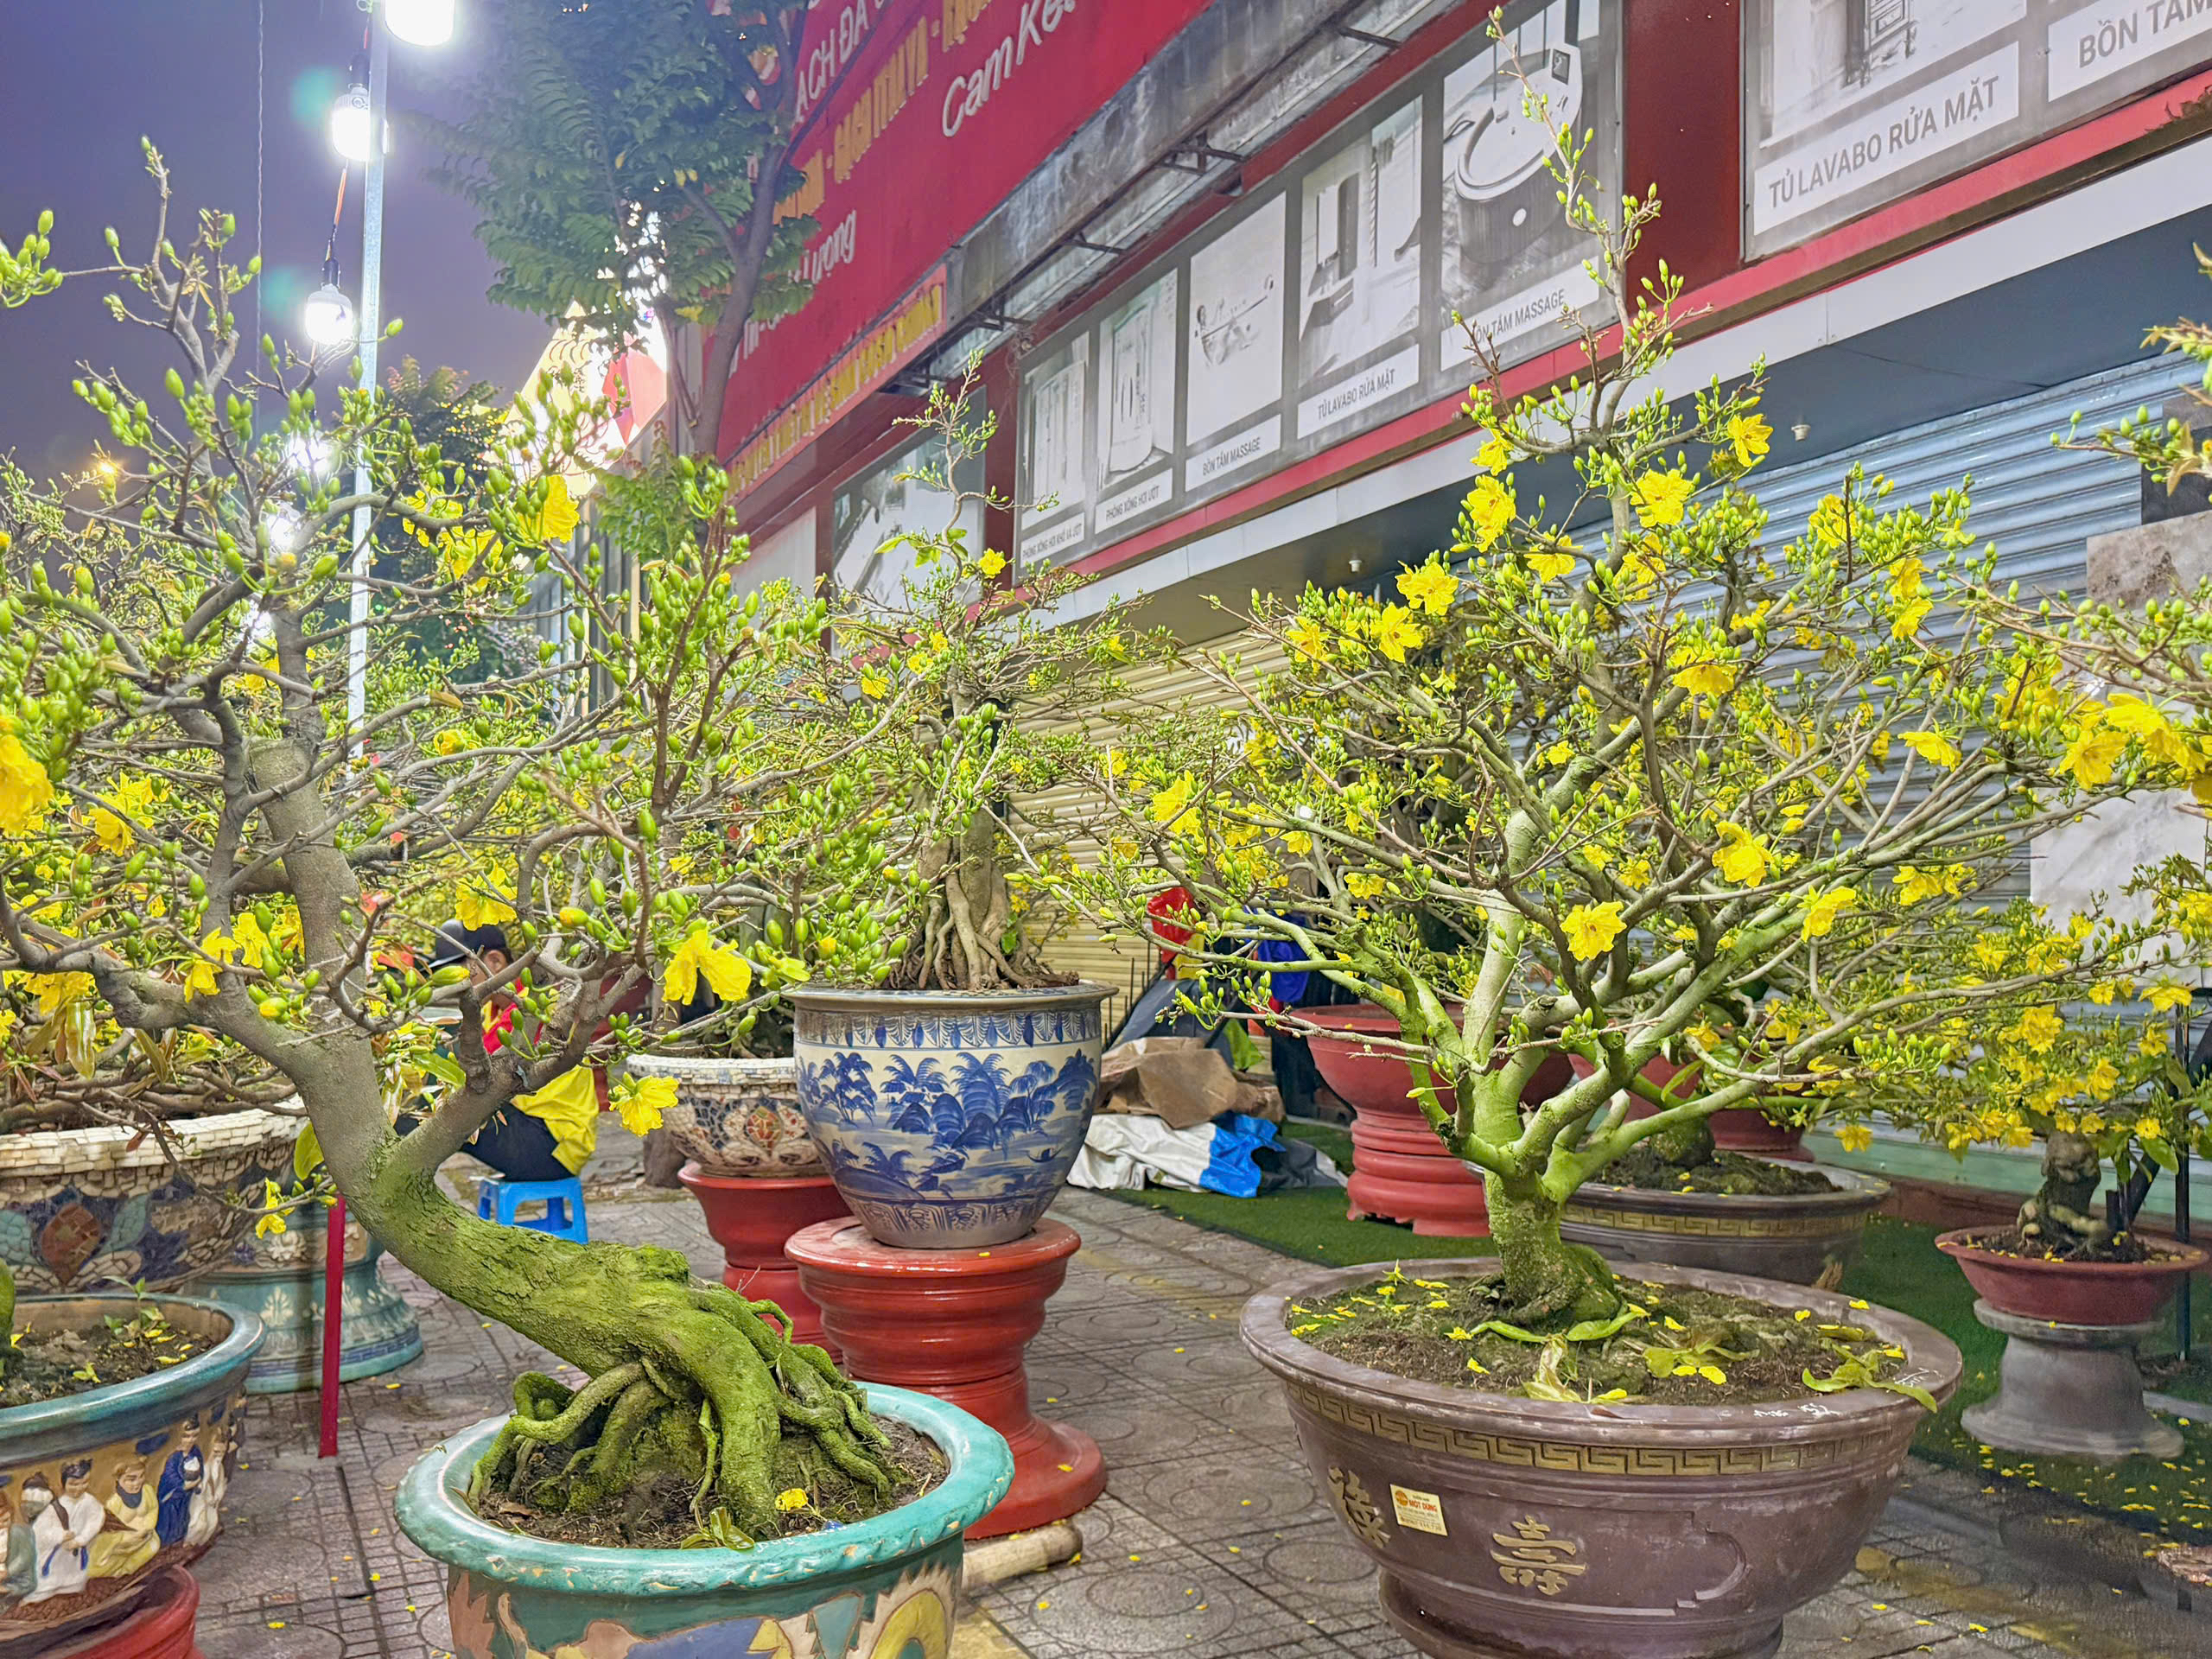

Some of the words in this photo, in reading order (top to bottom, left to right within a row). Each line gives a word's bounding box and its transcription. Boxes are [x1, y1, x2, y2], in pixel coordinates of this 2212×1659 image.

[2079, 12, 2138, 68] BỒN
[943, 36, 1014, 137] Cam
[1770, 168, 1795, 208] TỦ
[1798, 134, 1882, 197] LAVABO
[1889, 106, 1938, 154] RỬA
[1944, 76, 1999, 128] MẶT
[1515, 288, 1565, 327] MASSAGE
[1318, 397, 1328, 420] TỦ
[1328, 387, 1357, 416] LAVABO
[1358, 377, 1376, 399] RỬA
